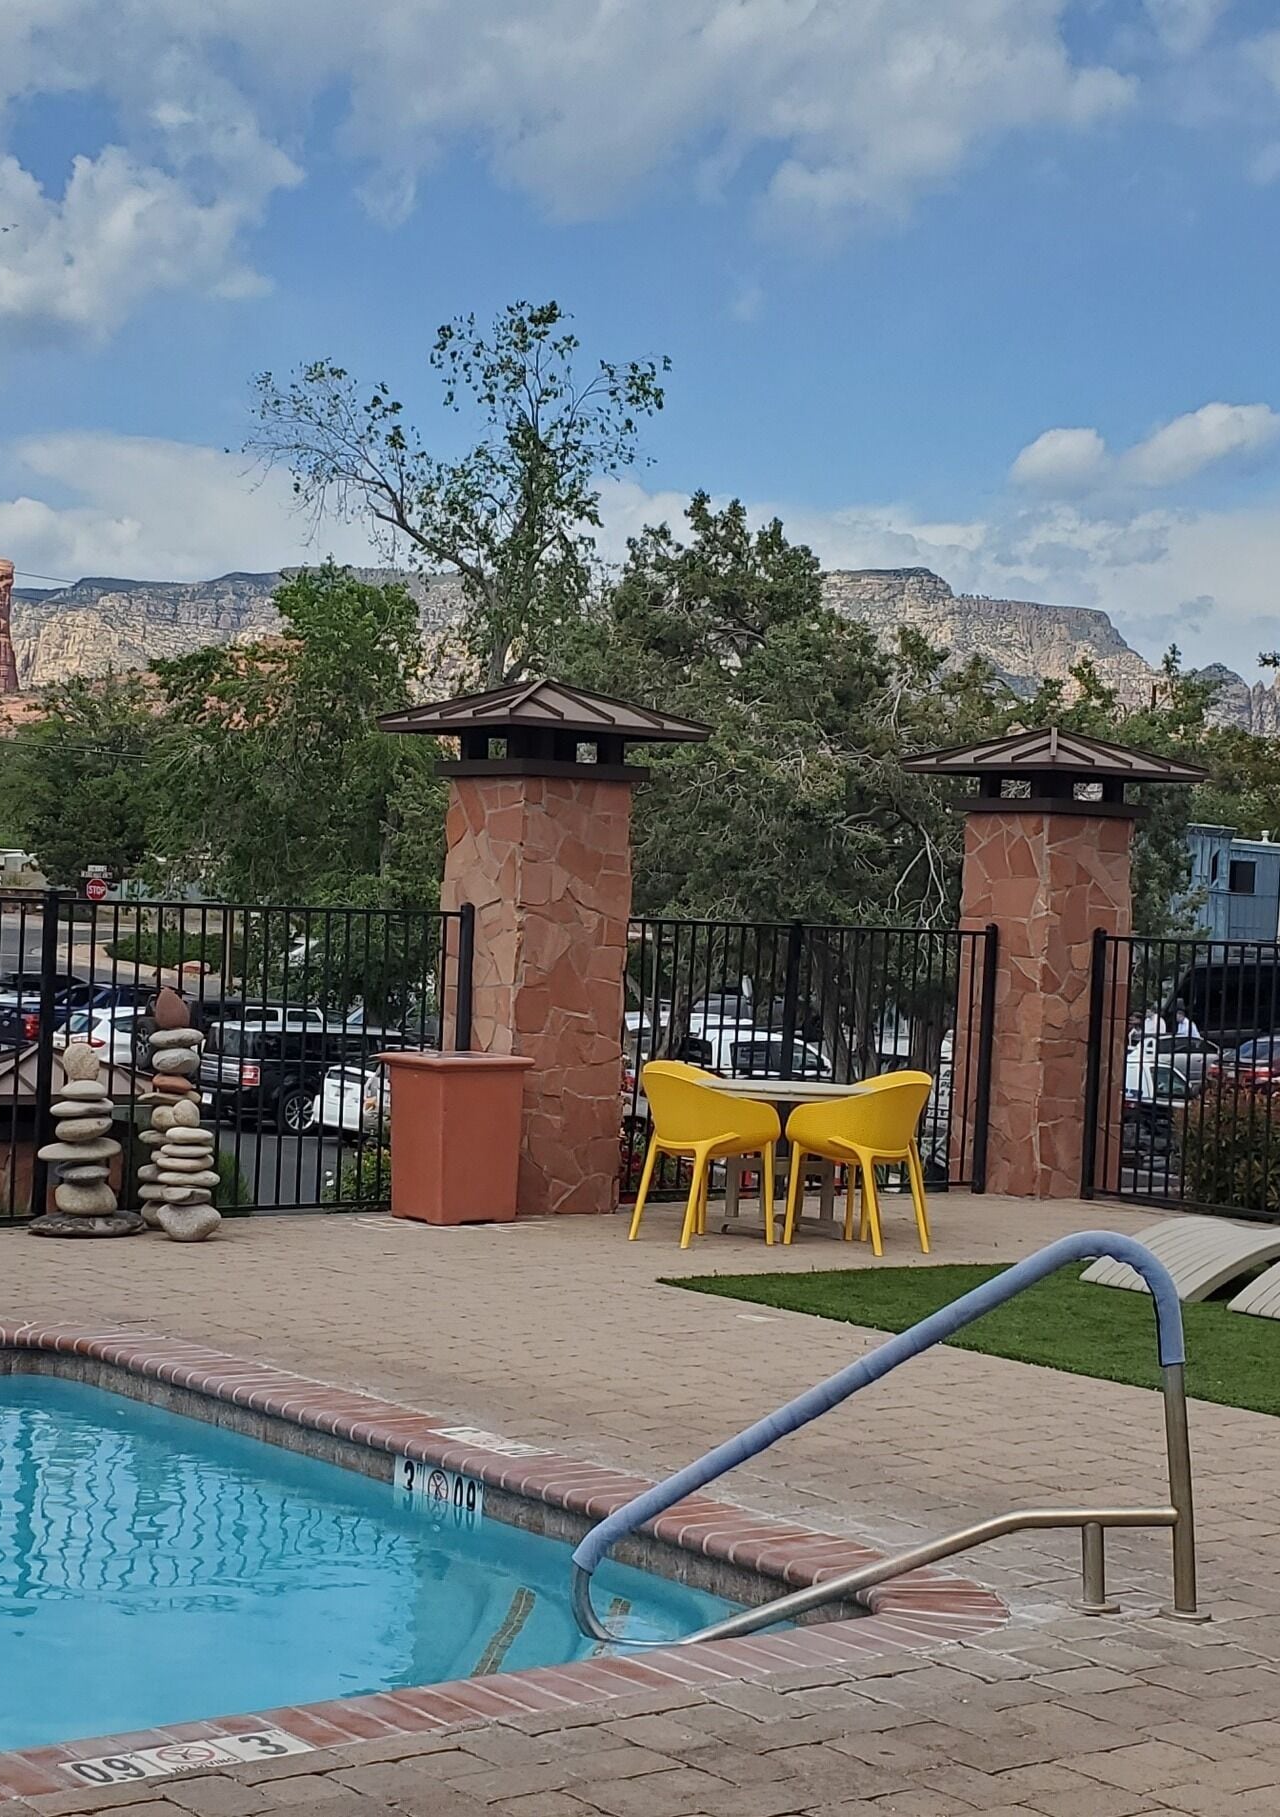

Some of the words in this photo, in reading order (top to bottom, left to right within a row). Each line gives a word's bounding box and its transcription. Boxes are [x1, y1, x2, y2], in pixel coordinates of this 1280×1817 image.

[88, 885, 106, 895] STOP
[404, 1460, 415, 1491] 3
[238, 1735, 289, 1755] 3
[70, 1758, 146, 1783] 0.9
